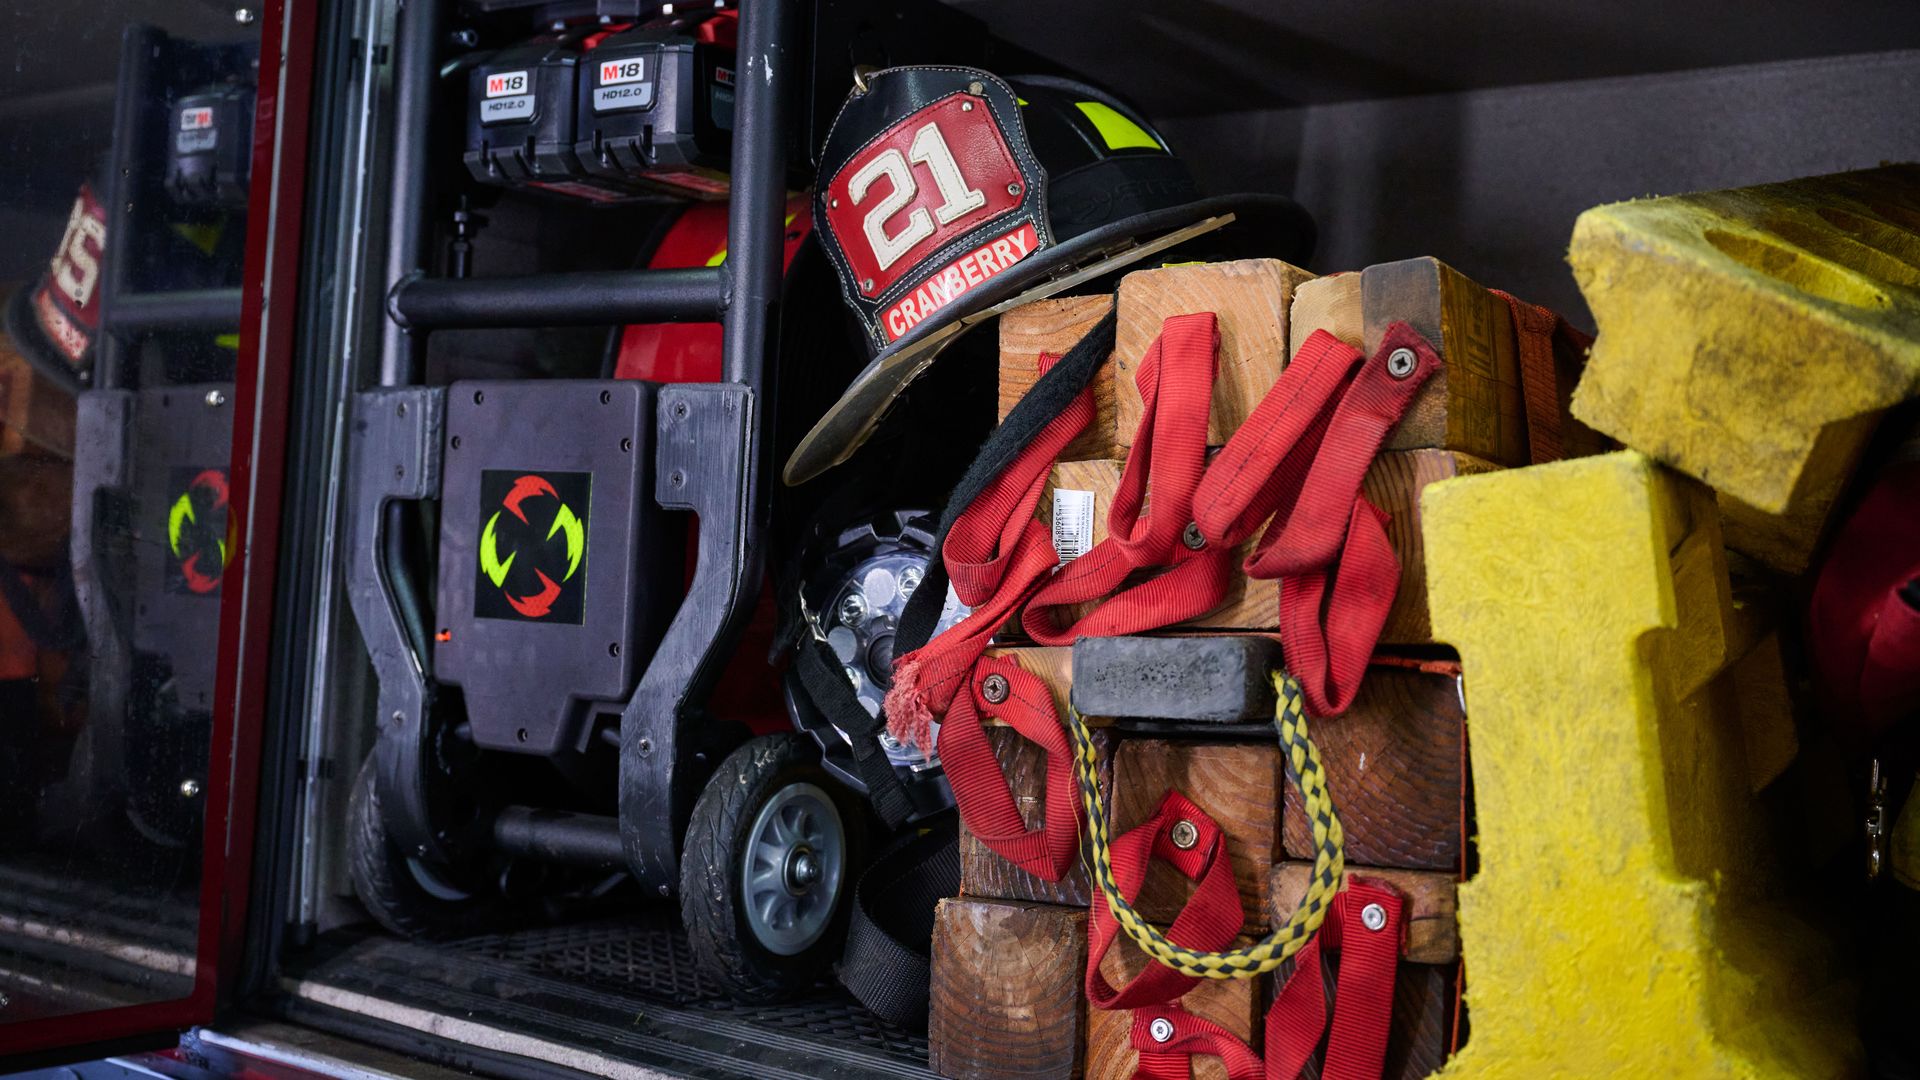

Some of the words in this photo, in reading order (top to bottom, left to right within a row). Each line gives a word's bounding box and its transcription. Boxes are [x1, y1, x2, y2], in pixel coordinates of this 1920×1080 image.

[603, 63, 640, 80] M18
[490, 77, 524, 92] M18
[602, 88, 642, 100] HD12.0
[489, 100, 525, 111] HD12.0
[848, 121, 986, 272] 21
[888, 229, 1030, 337] CRANBERRY
